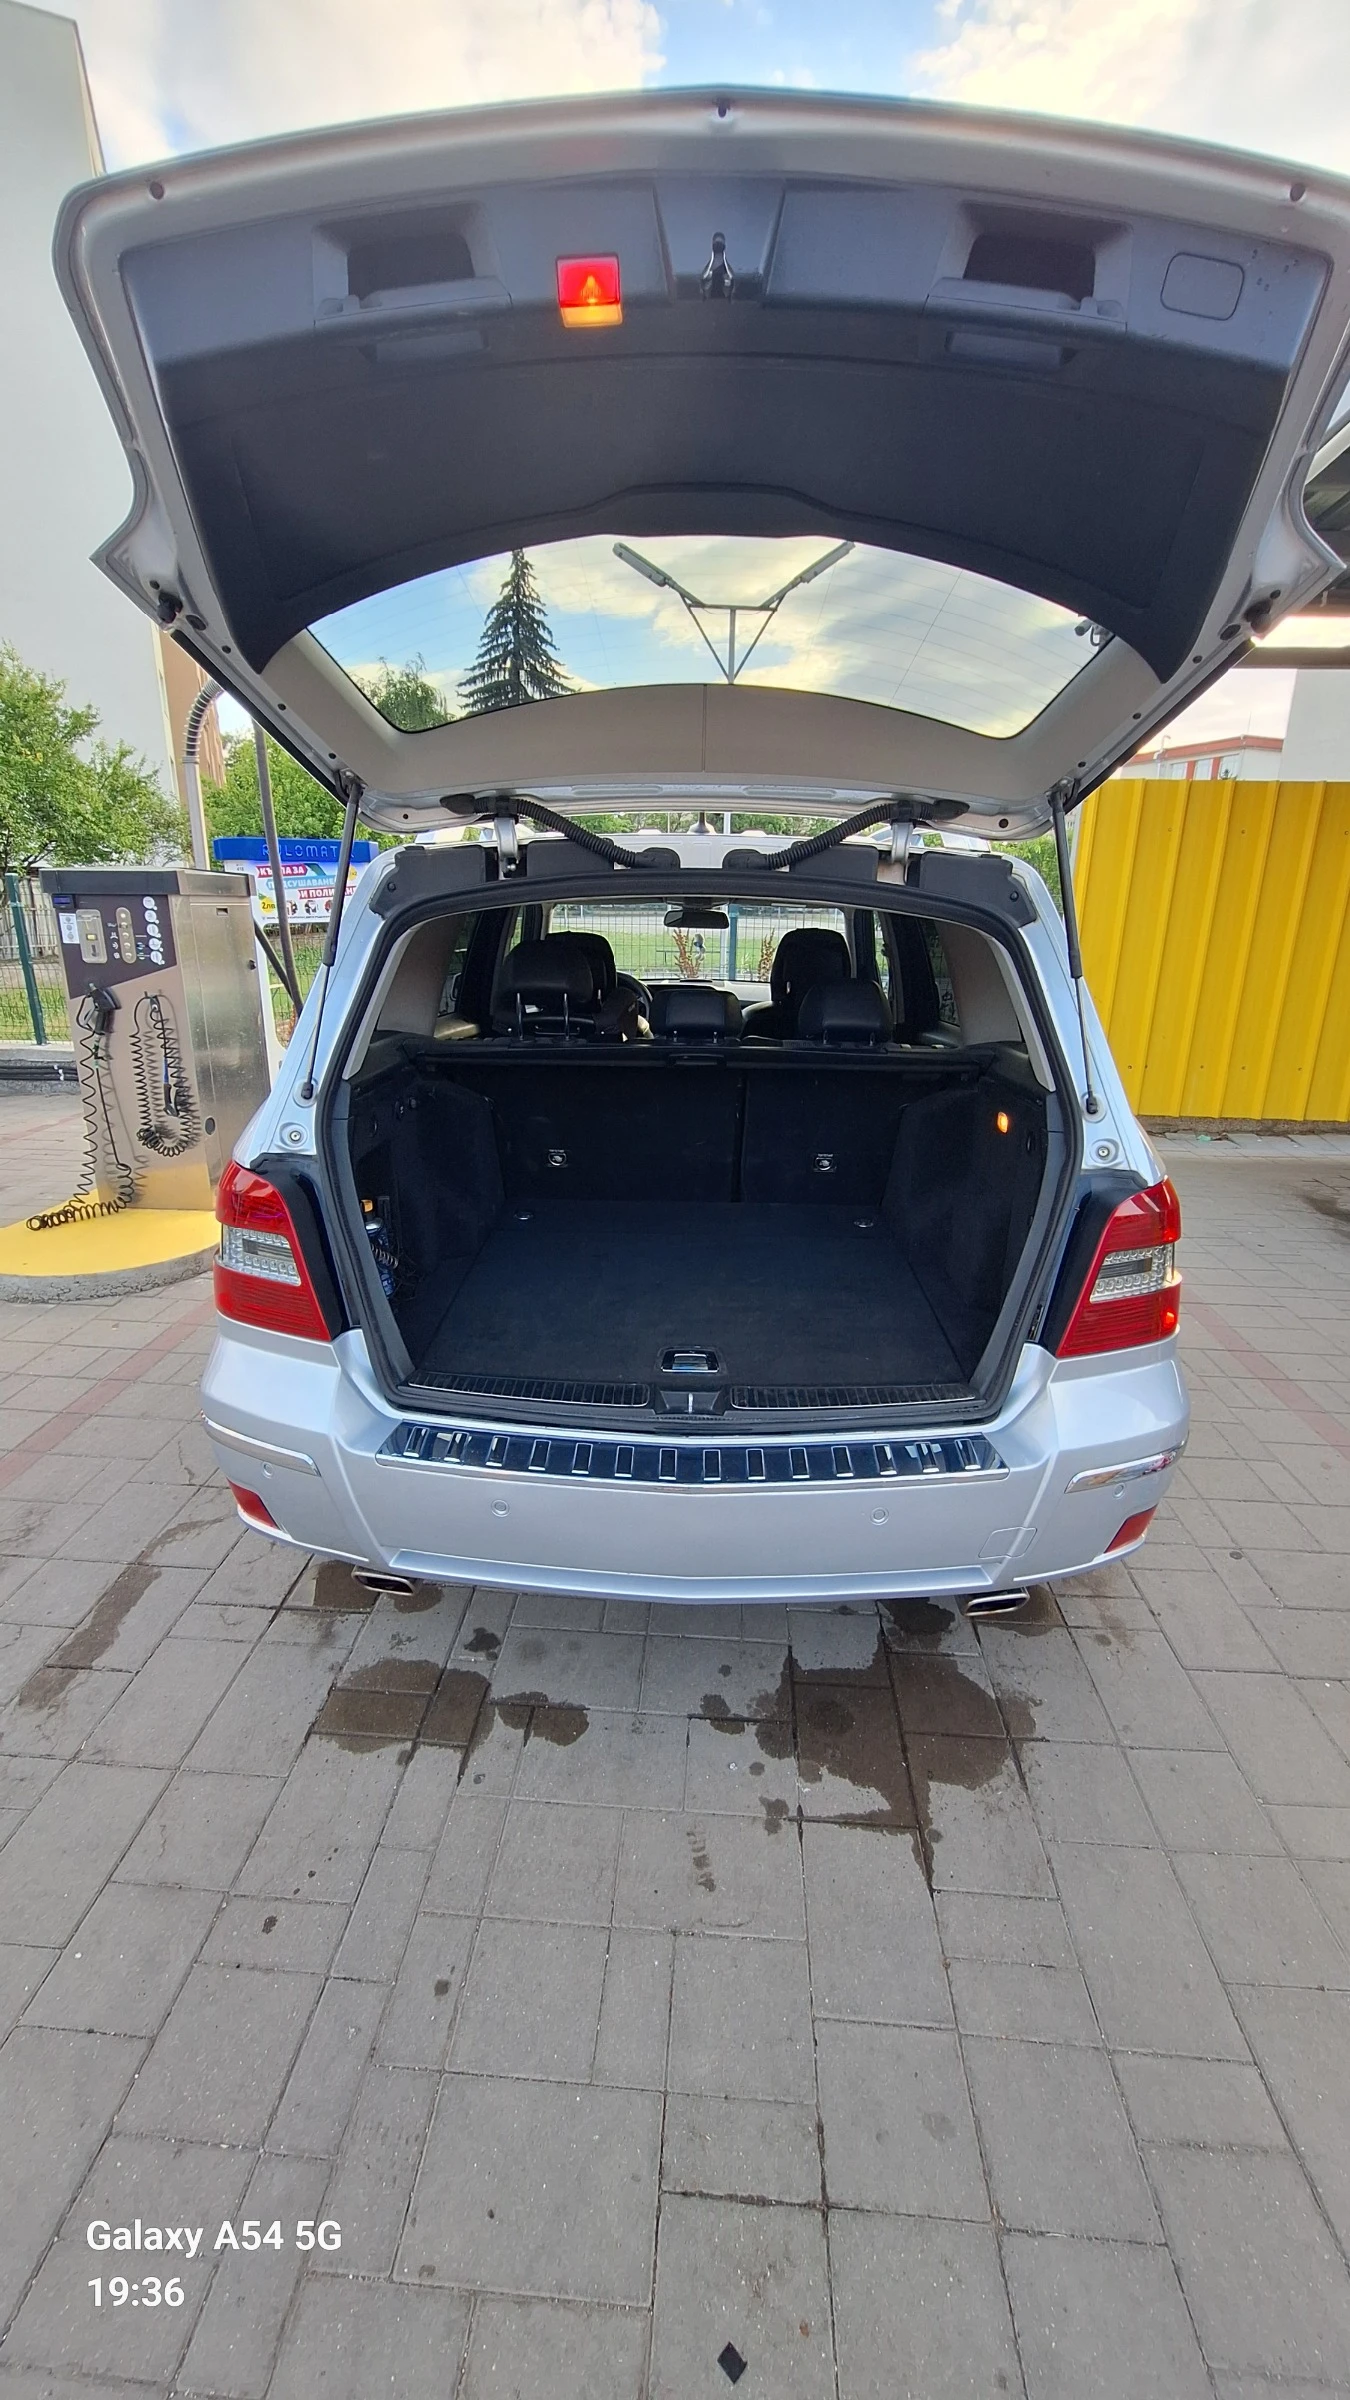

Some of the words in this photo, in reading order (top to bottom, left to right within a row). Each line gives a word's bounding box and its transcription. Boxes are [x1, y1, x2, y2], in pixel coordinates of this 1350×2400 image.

[262, 844, 354, 858] RLOMAT
[259, 865, 292, 876] КЪПА
[293, 865, 305, 874] ЗА
[267, 878, 335, 889] ПДСУШАВАНЕ
[300, 889, 308, 898] И
